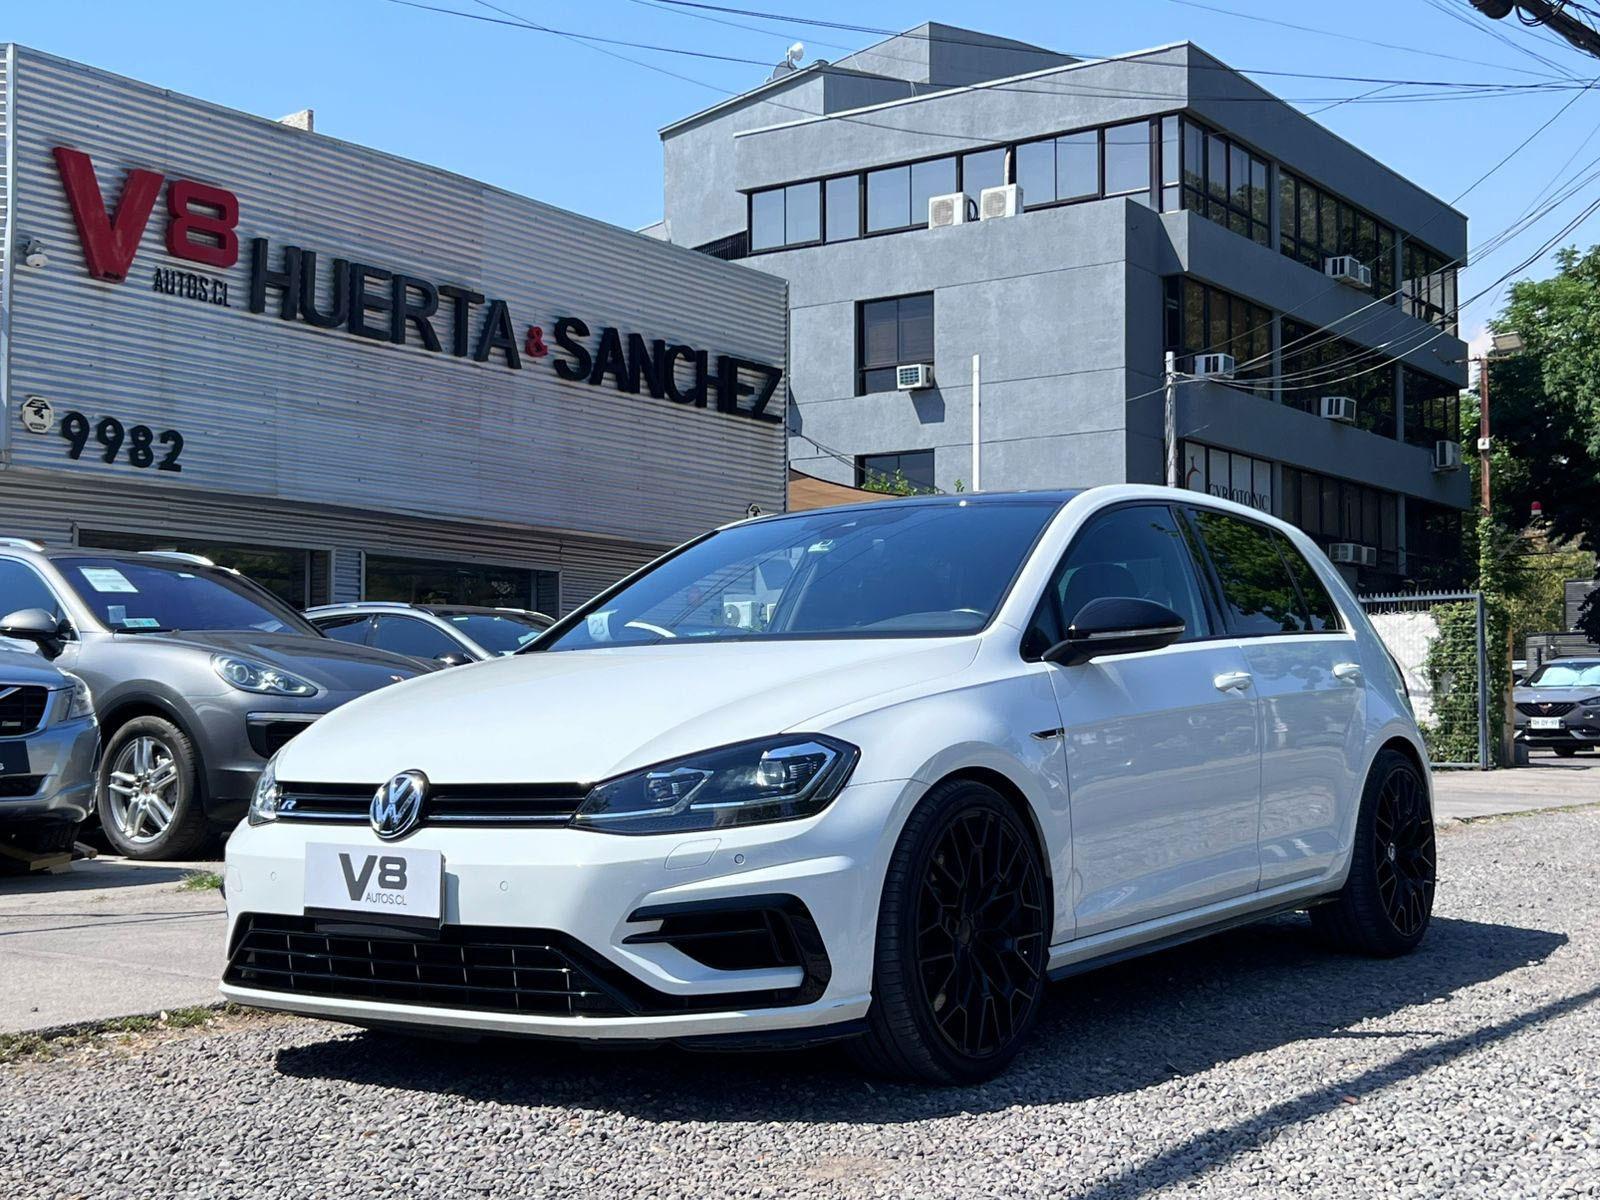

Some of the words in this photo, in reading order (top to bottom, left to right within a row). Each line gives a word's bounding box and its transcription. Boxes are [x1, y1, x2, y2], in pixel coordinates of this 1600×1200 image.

[53, 146, 239, 283] V8
[153, 267, 231, 307] AUTOS.CL
[250, 238, 522, 370] HUERTA
[525, 326, 548, 358] &
[553, 317, 783, 423] SANCHEZ
[61, 411, 184, 472] 9982
[338, 853, 407, 901] V8
[365, 892, 407, 906] AUTOS.CL
